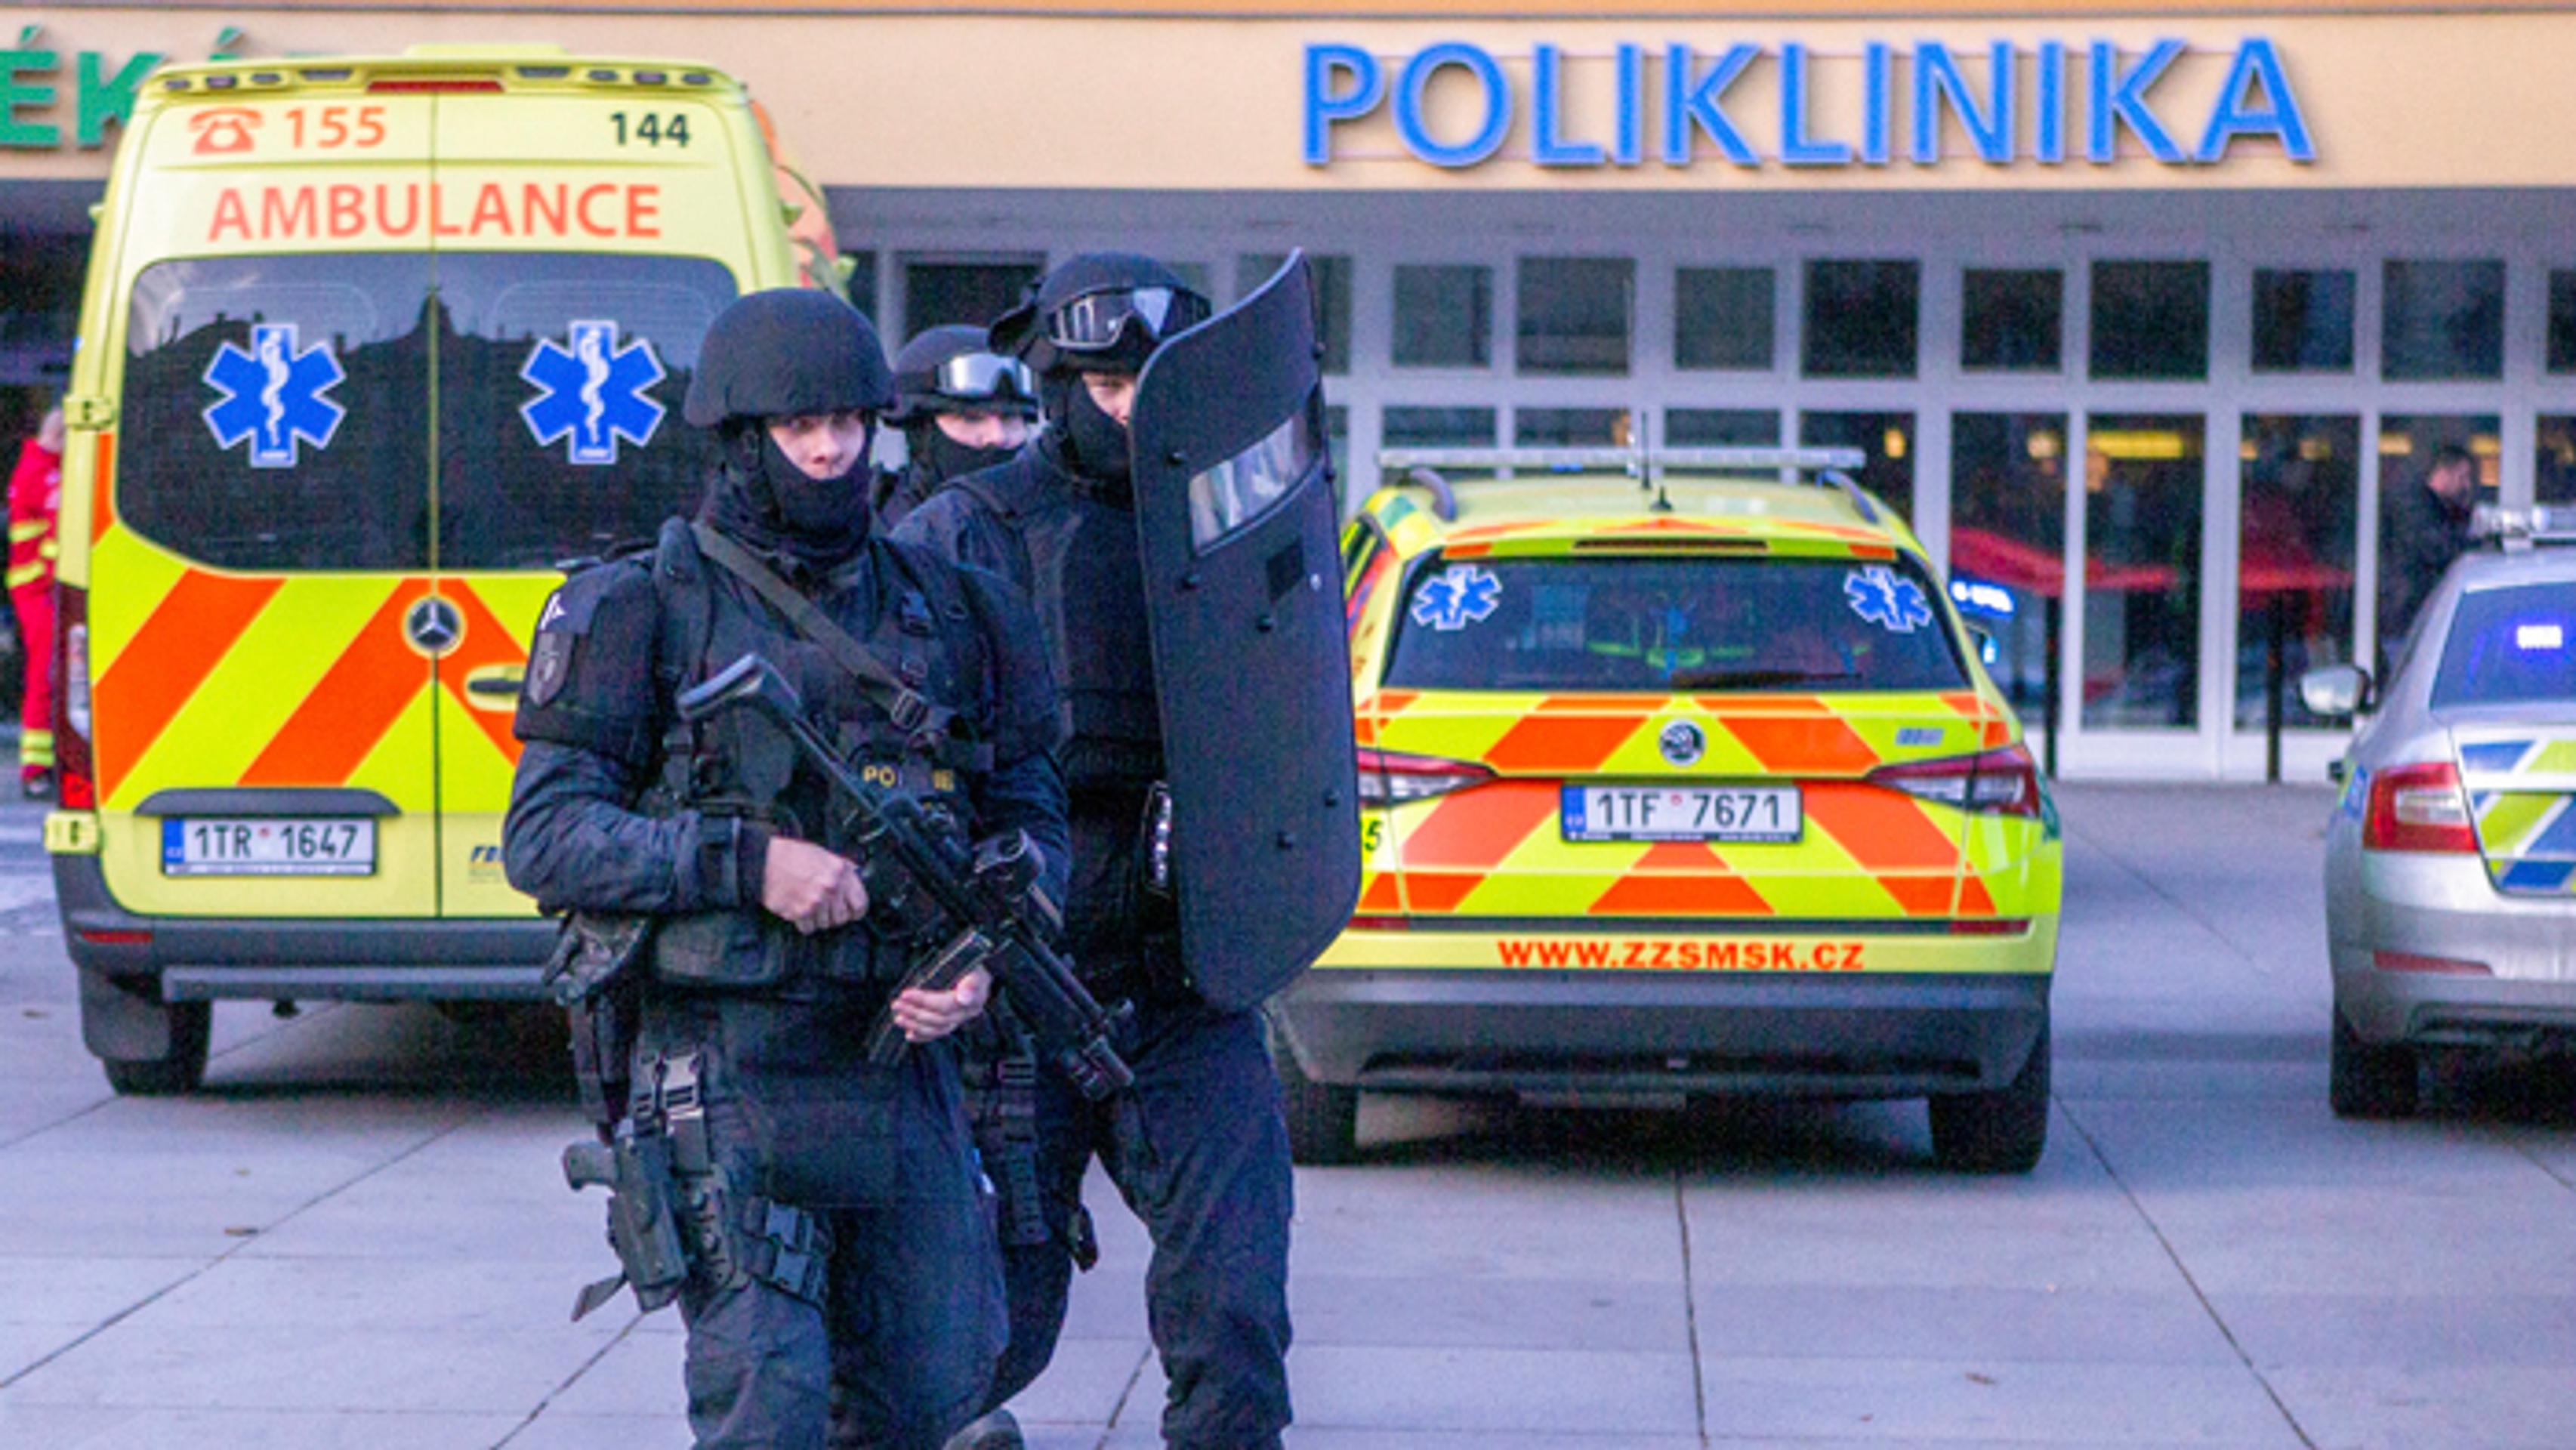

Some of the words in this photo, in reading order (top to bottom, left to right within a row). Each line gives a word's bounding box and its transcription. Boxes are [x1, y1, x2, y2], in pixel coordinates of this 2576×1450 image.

[1303, 39, 2316, 166] POLIKLINIKA
[285, 107, 386, 148] 155
[609, 113, 690, 147] 144
[207, 184, 662, 241] AMBULANCE
[1597, 793, 1660, 826] 1TF
[1692, 794, 1779, 827] 7671
[195, 824, 251, 858] 1TR
[280, 824, 358, 858] 1647
[1498, 941, 1865, 970] WWW.ZZSMSK.CZ
